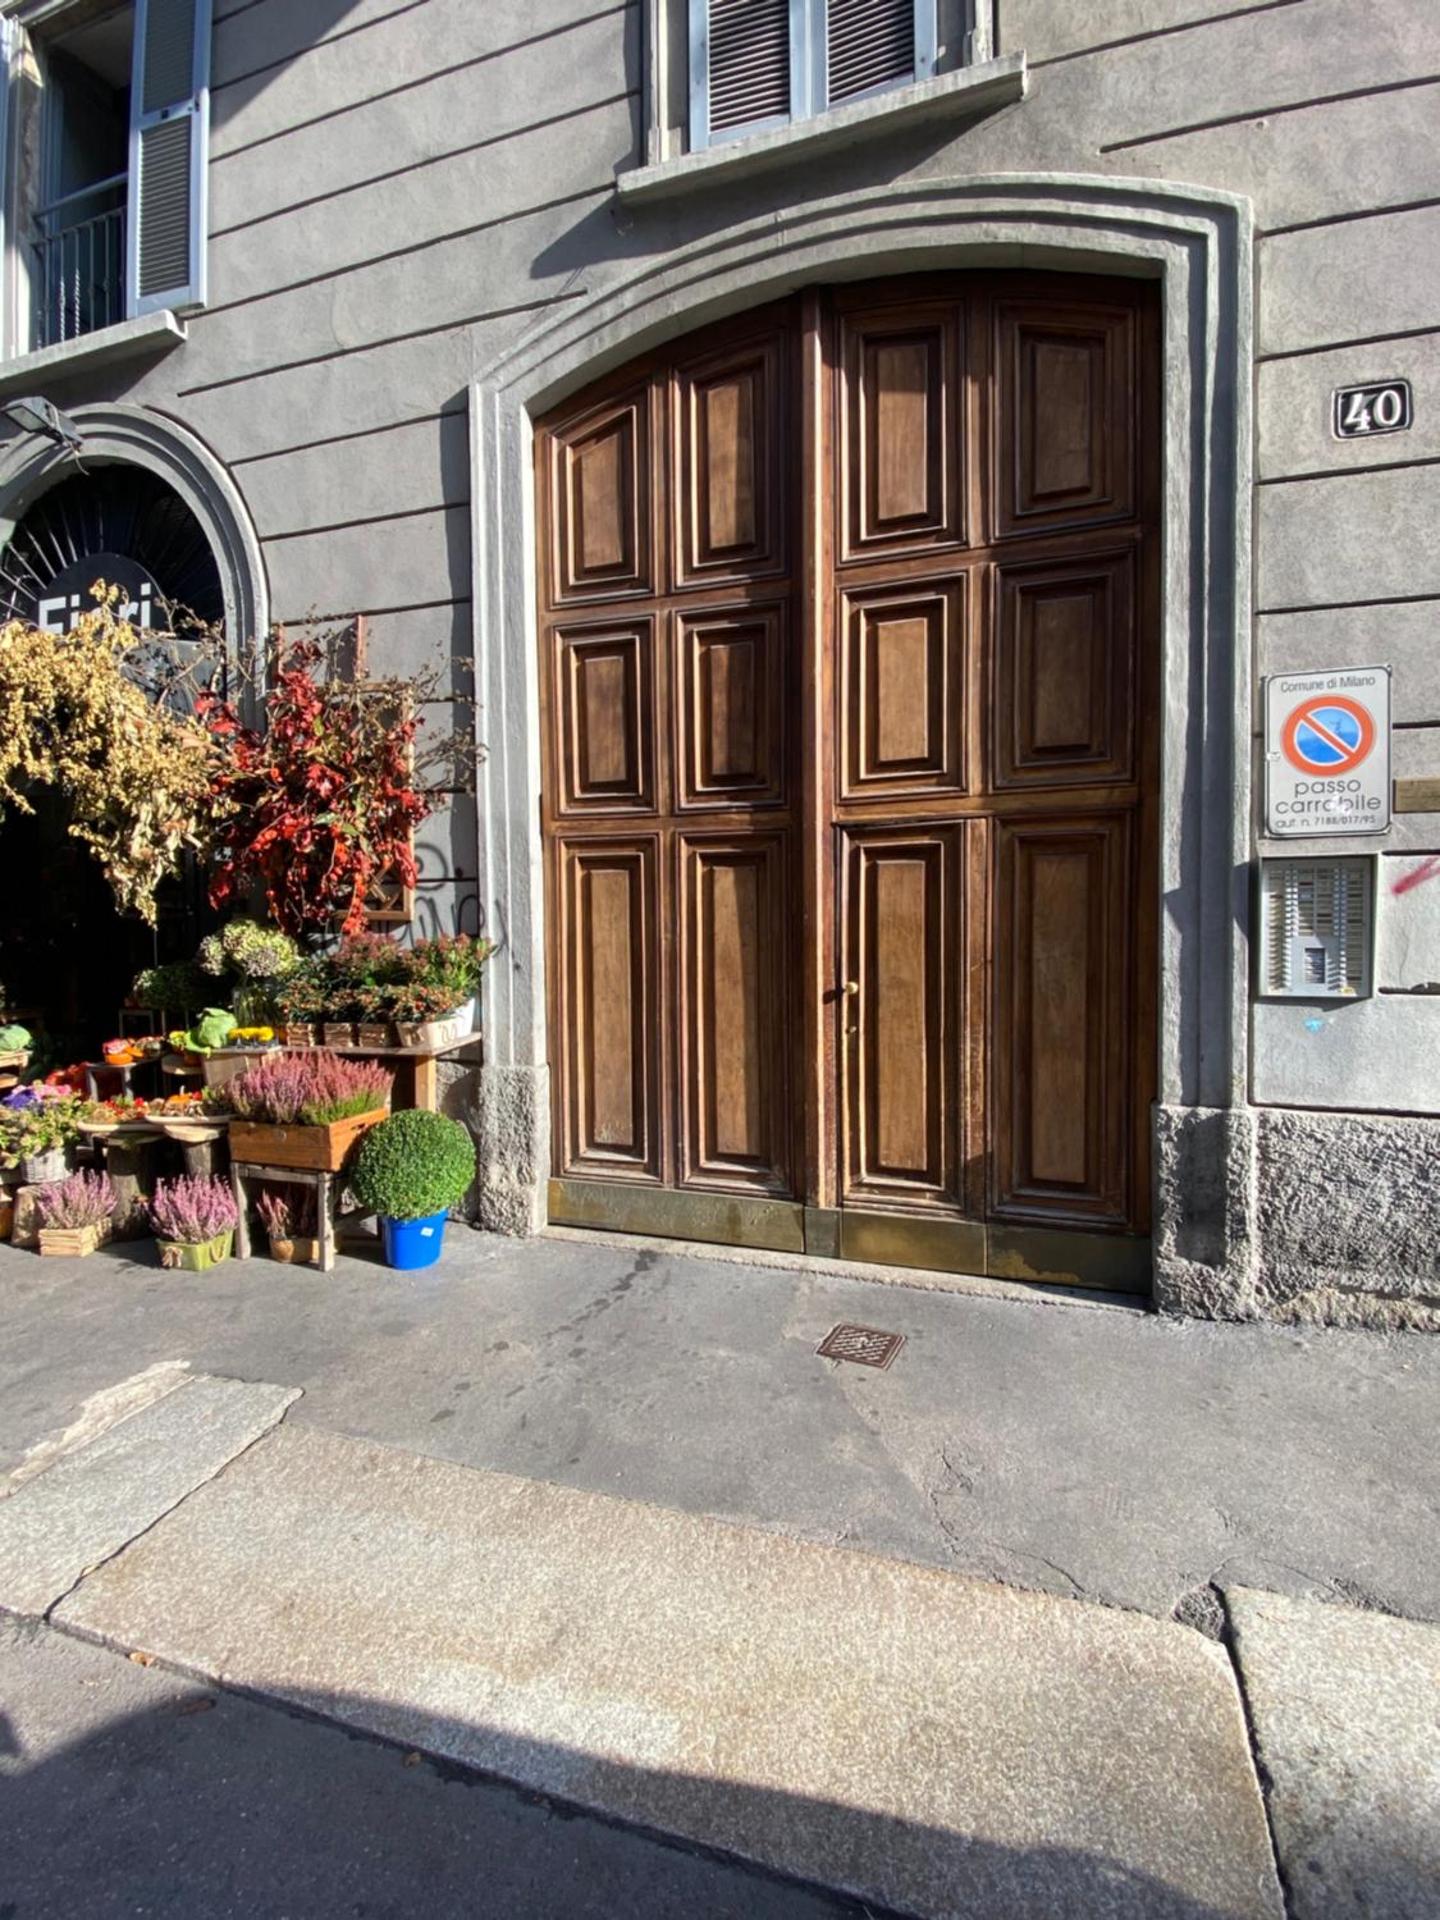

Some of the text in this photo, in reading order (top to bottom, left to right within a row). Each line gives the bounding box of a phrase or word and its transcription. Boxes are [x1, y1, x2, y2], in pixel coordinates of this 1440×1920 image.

[1343, 389, 1402, 431] 40
[38, 582, 151, 636] Firi
[1280, 676, 1376, 693] Comune di Milano
[1294, 779, 1361, 798] passo
